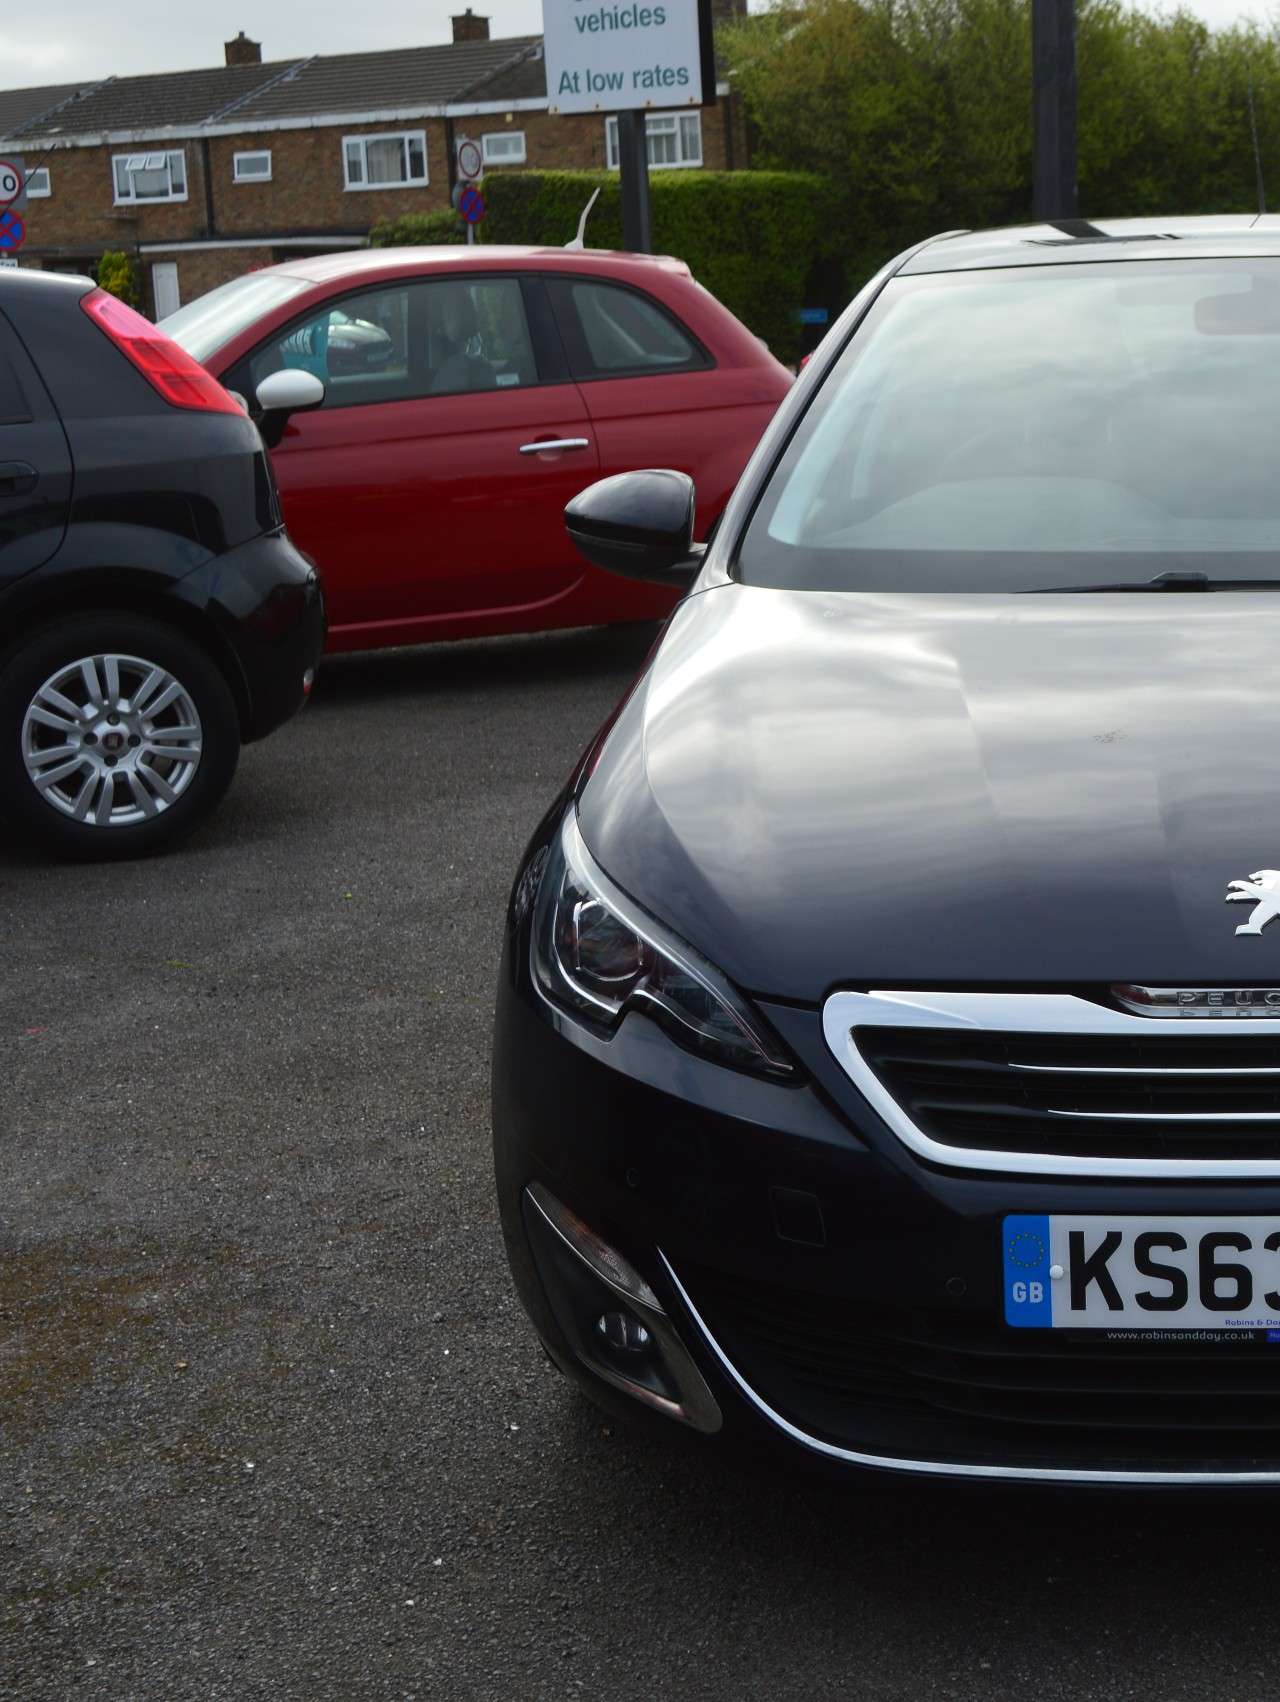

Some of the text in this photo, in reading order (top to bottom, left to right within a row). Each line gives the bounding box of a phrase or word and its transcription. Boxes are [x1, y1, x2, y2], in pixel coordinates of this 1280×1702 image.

[574, 4, 666, 33] vehicles
[558, 64, 689, 95] At low rates
[1012, 1281, 1044, 1303] GB
[1225, 1319, 1254, 1327] Robins
[1256, 1318, 1264, 1327] &
[1107, 1331, 1255, 1342] www.robinsandday.co.uk
